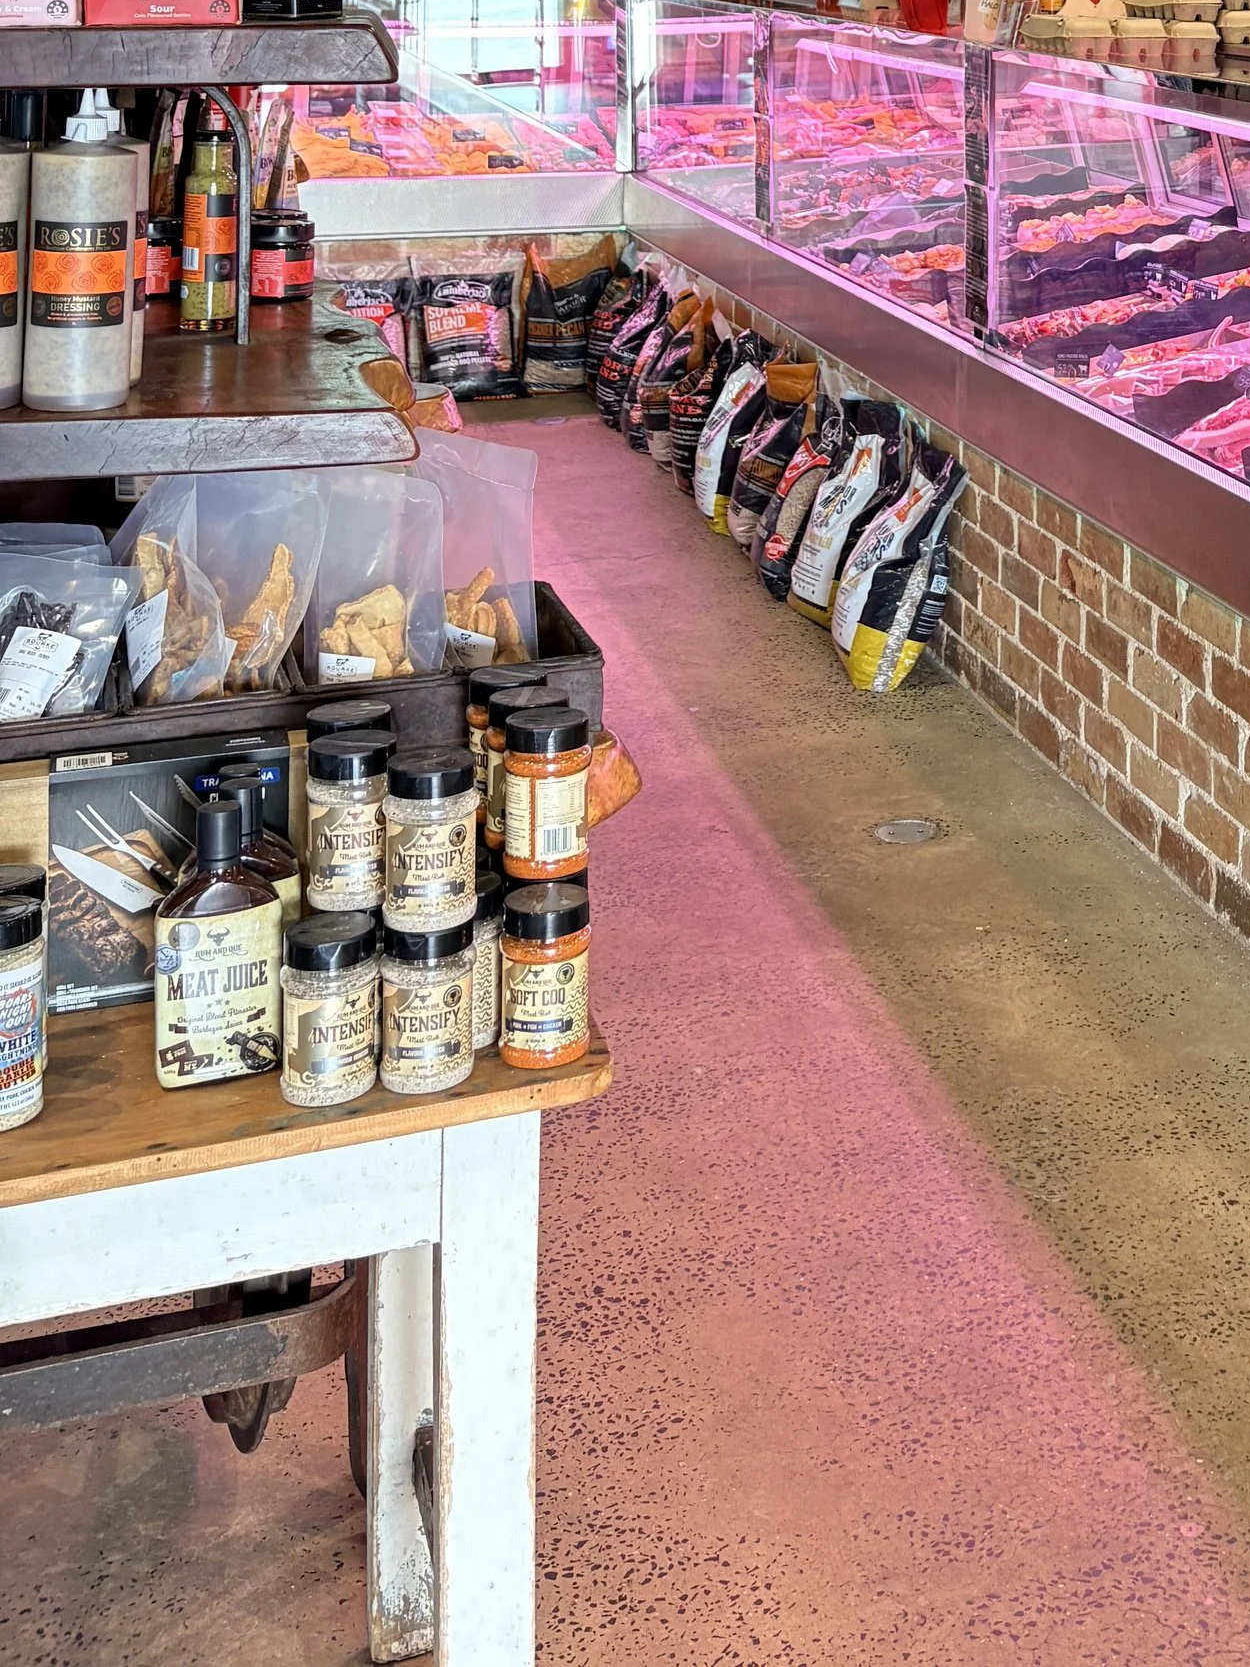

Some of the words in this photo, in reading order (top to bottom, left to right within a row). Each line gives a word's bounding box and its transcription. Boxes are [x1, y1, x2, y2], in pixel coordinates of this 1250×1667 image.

[14, 5, 42, 13] Cream
[150, 5, 175, 13] Sour
[40, 227, 121, 246] ROSIE'S
[51, 295, 71, 303] Honey
[51, 302, 100, 312] DRESSING
[428, 304, 482, 320] SUPREME
[429, 316, 466, 334] BLEND
[320, 827, 386, 851] INTENSIF
[394, 846, 466, 871] INTENSIFY
[412, 874, 430, 882] Meat
[431, 873, 445, 881] Rub
[195, 947, 211, 958] RUM
[213, 948, 227, 956] AND
[229, 944, 242, 955] QUE
[167, 968, 219, 1002] MEAT
[222, 959, 268, 993] JUICE
[511, 988, 538, 1006] SOFT
[542, 987, 566, 1006] COQ
[6, 1015, 27, 1029] OUT
[177, 1013, 203, 1025] Original
[205, 1010, 226, 1022] Blend
[389, 1006, 460, 1033] INTENSIFY
[312, 1011, 374, 1045] INTENSIF
[407, 1034, 424, 1043] Meat
[426, 1034, 440, 1042] Rub
[183, 1062, 198, 1071] NZ
